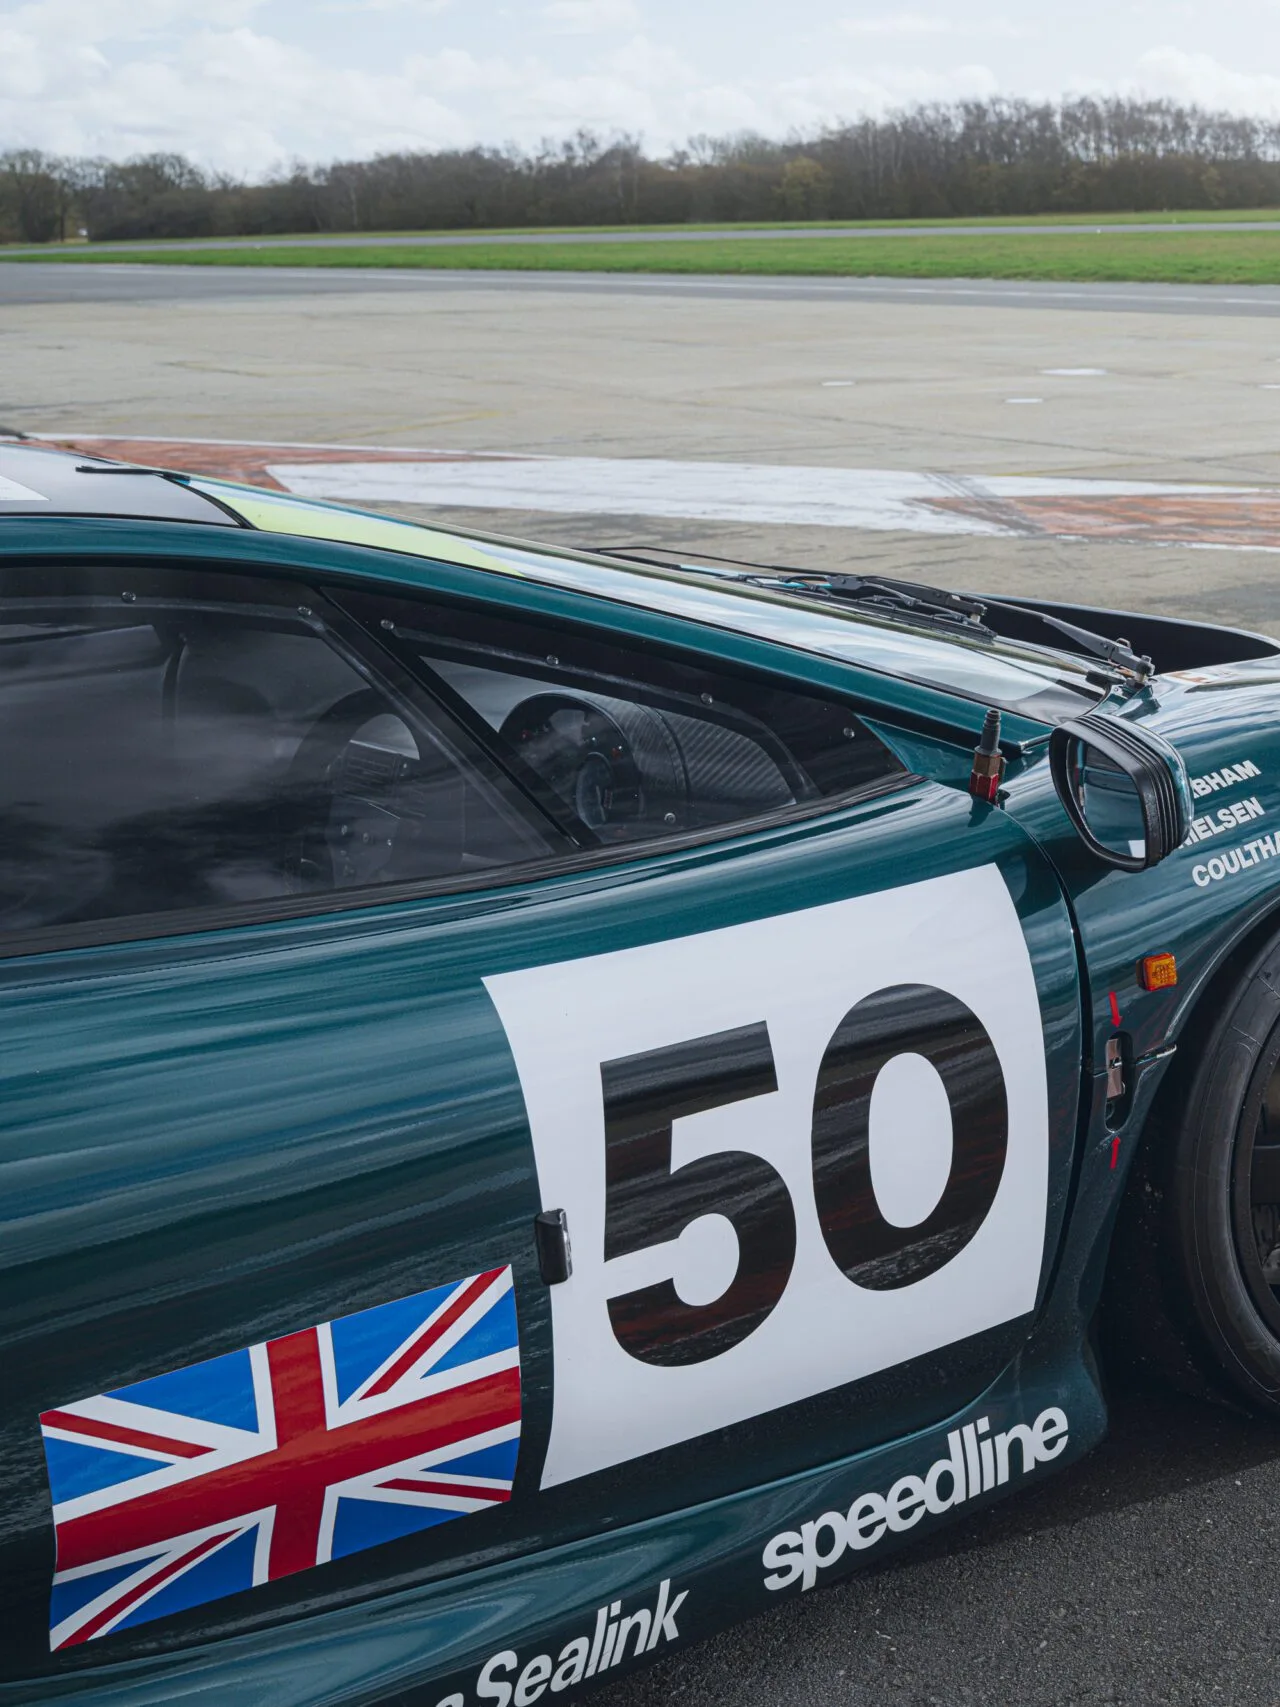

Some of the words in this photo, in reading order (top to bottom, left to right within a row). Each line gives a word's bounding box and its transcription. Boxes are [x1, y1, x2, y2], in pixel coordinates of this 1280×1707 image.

[599, 982, 1009, 1368] 50
[762, 1406, 1069, 1592] speedline
[476, 1578, 690, 1707] Sealink
